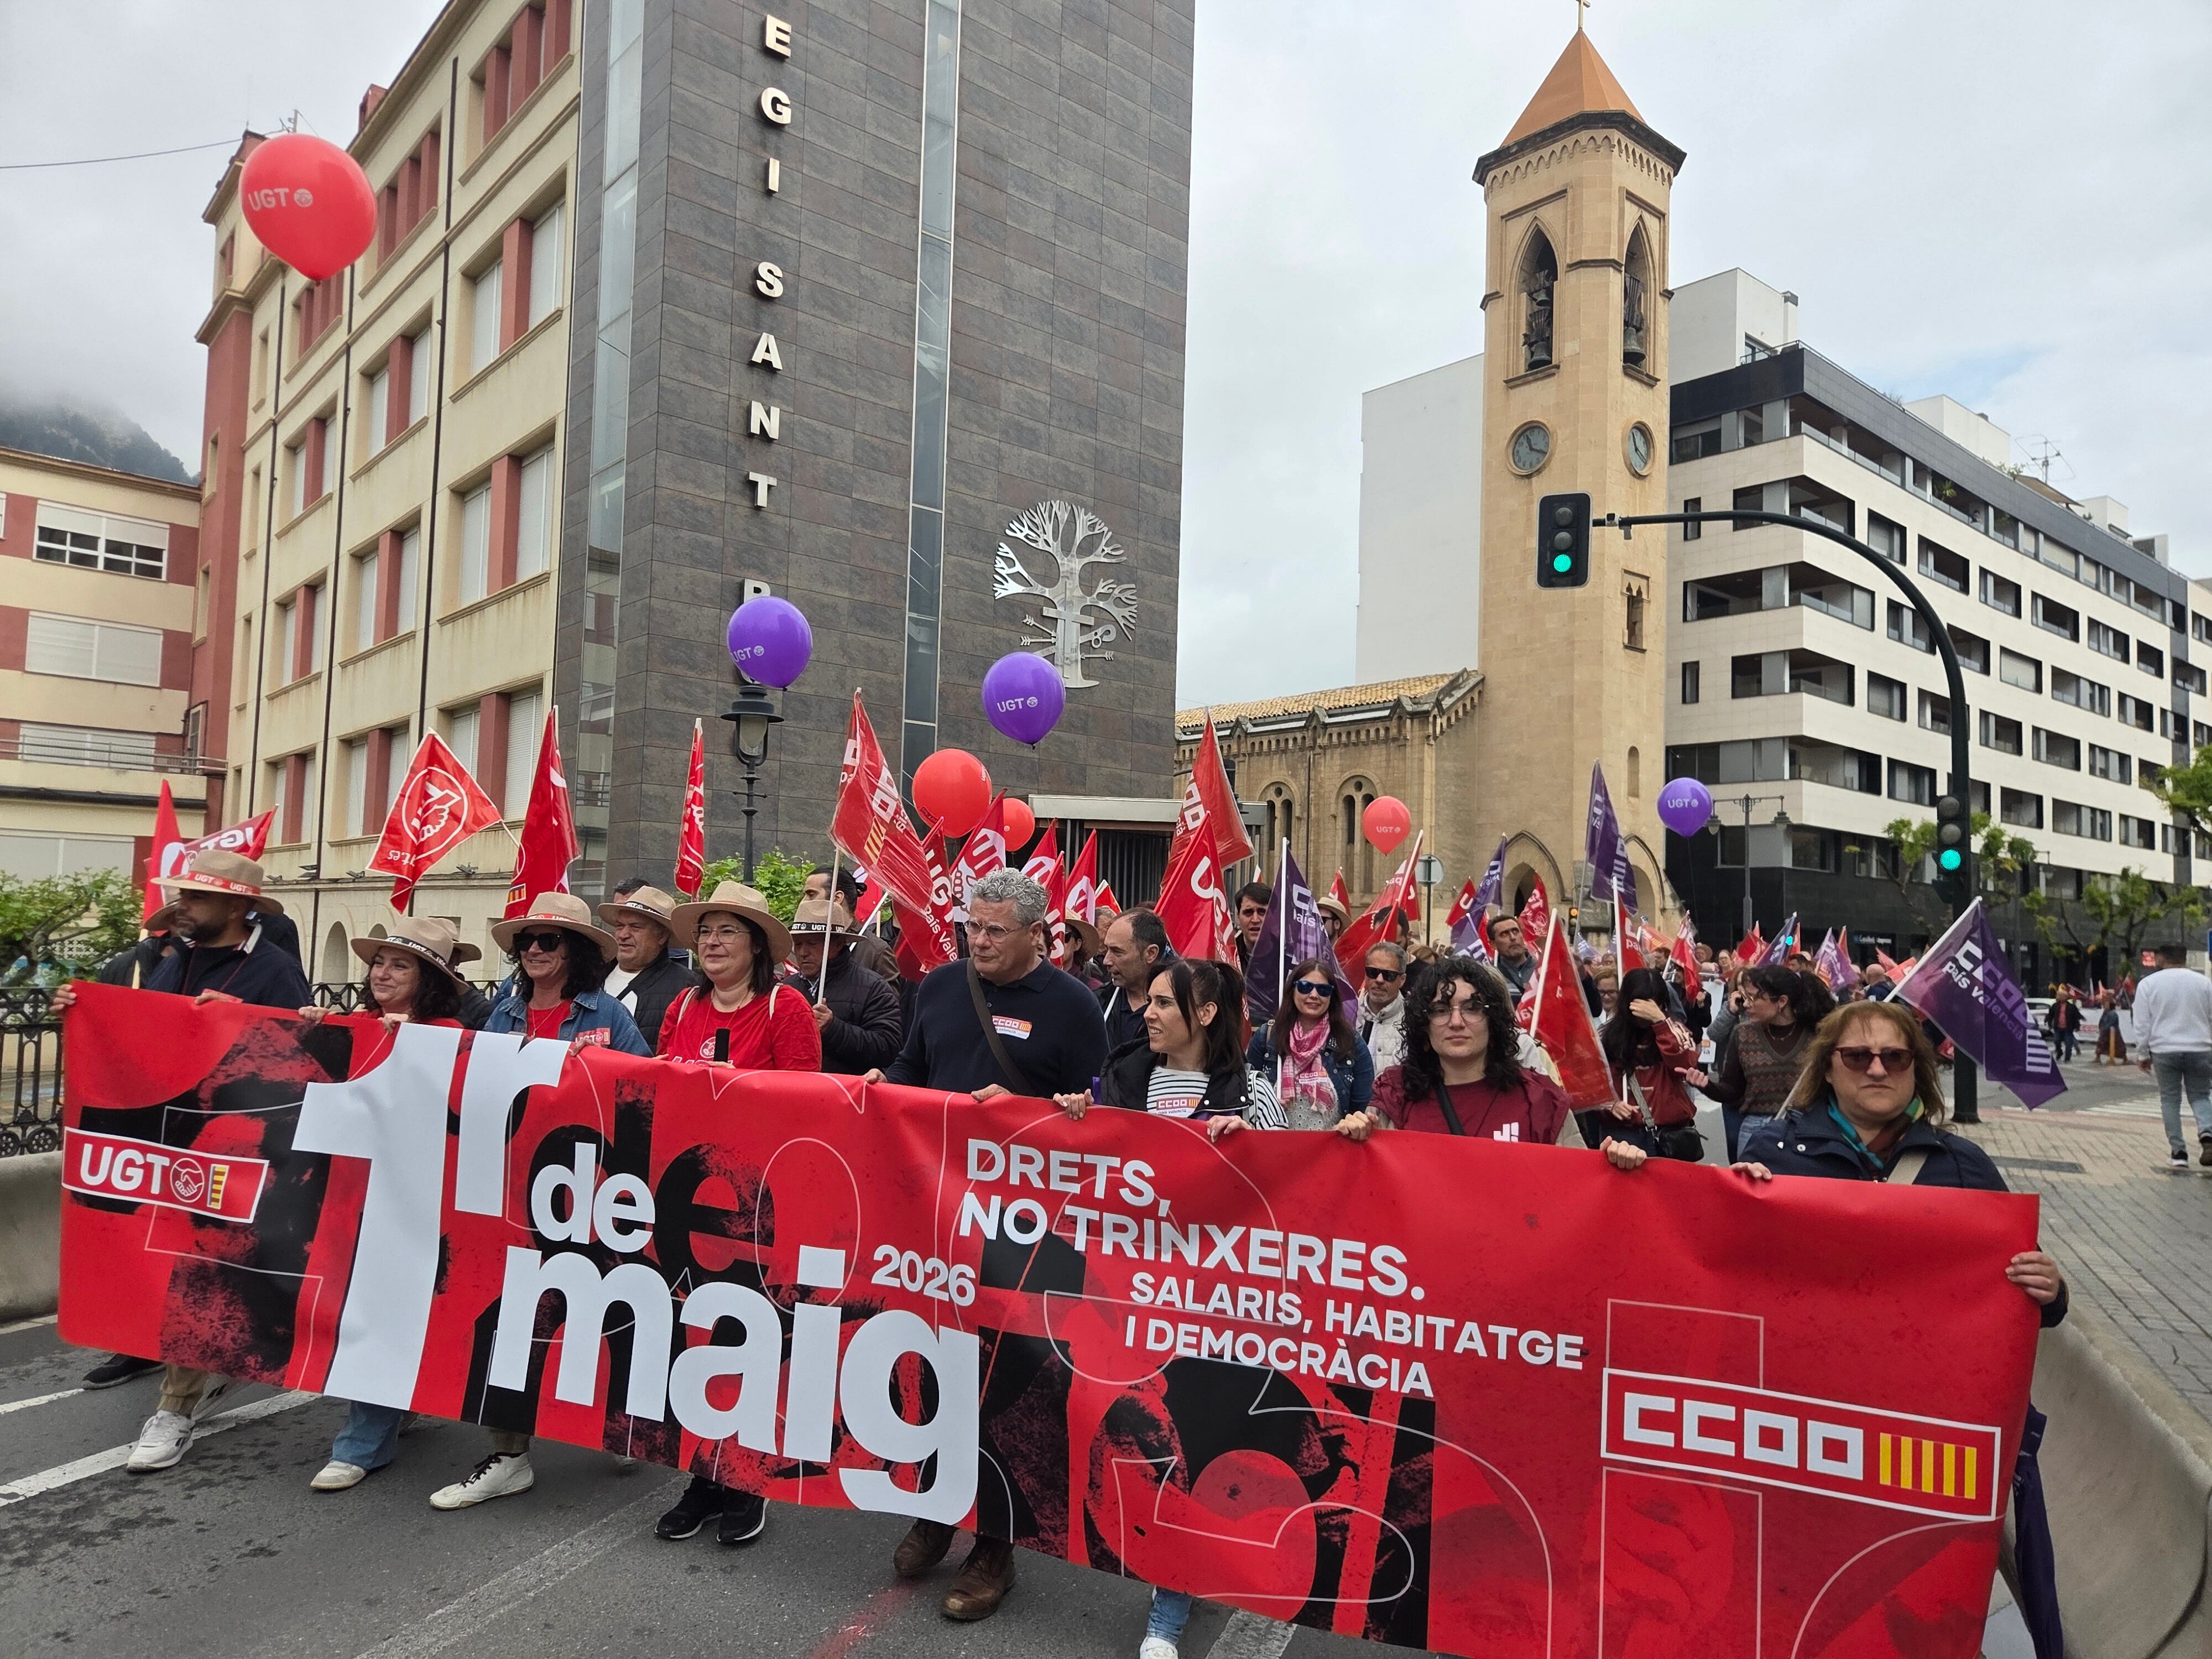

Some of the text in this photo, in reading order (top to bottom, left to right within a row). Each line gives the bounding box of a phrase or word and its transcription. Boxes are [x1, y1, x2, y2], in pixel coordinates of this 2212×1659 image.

[248, 188, 289, 211] UGT
[749, 261, 783, 508] SANT
[731, 647, 752, 663] UGT
[997, 698, 1024, 712] UGT
[1668, 799, 1690, 808] UGT
[194, 874, 247, 894] UGT UGT
[992, 1018, 1020, 1029] CCOO
[1942, 961, 2024, 1040] país valencià
[1955, 940, 2036, 1028] CCOO
[1158, 1099, 1187, 1108] CCOO
[80, 1143, 170, 1194] UGT
[531, 1142, 656, 1254] de
[968, 1138, 1171, 1217] DRETS,
[872, 1244, 976, 1307] 2026
[959, 1191, 1426, 1301] NO TRINXERES.
[1125, 1315, 1434, 1398] I DEMOCRÀCIA
[1131, 1272, 1584, 1371] SALARIS, HABITATGE
[488, 1244, 979, 1526] maig
[1624, 1392, 1864, 1480] CCOO
